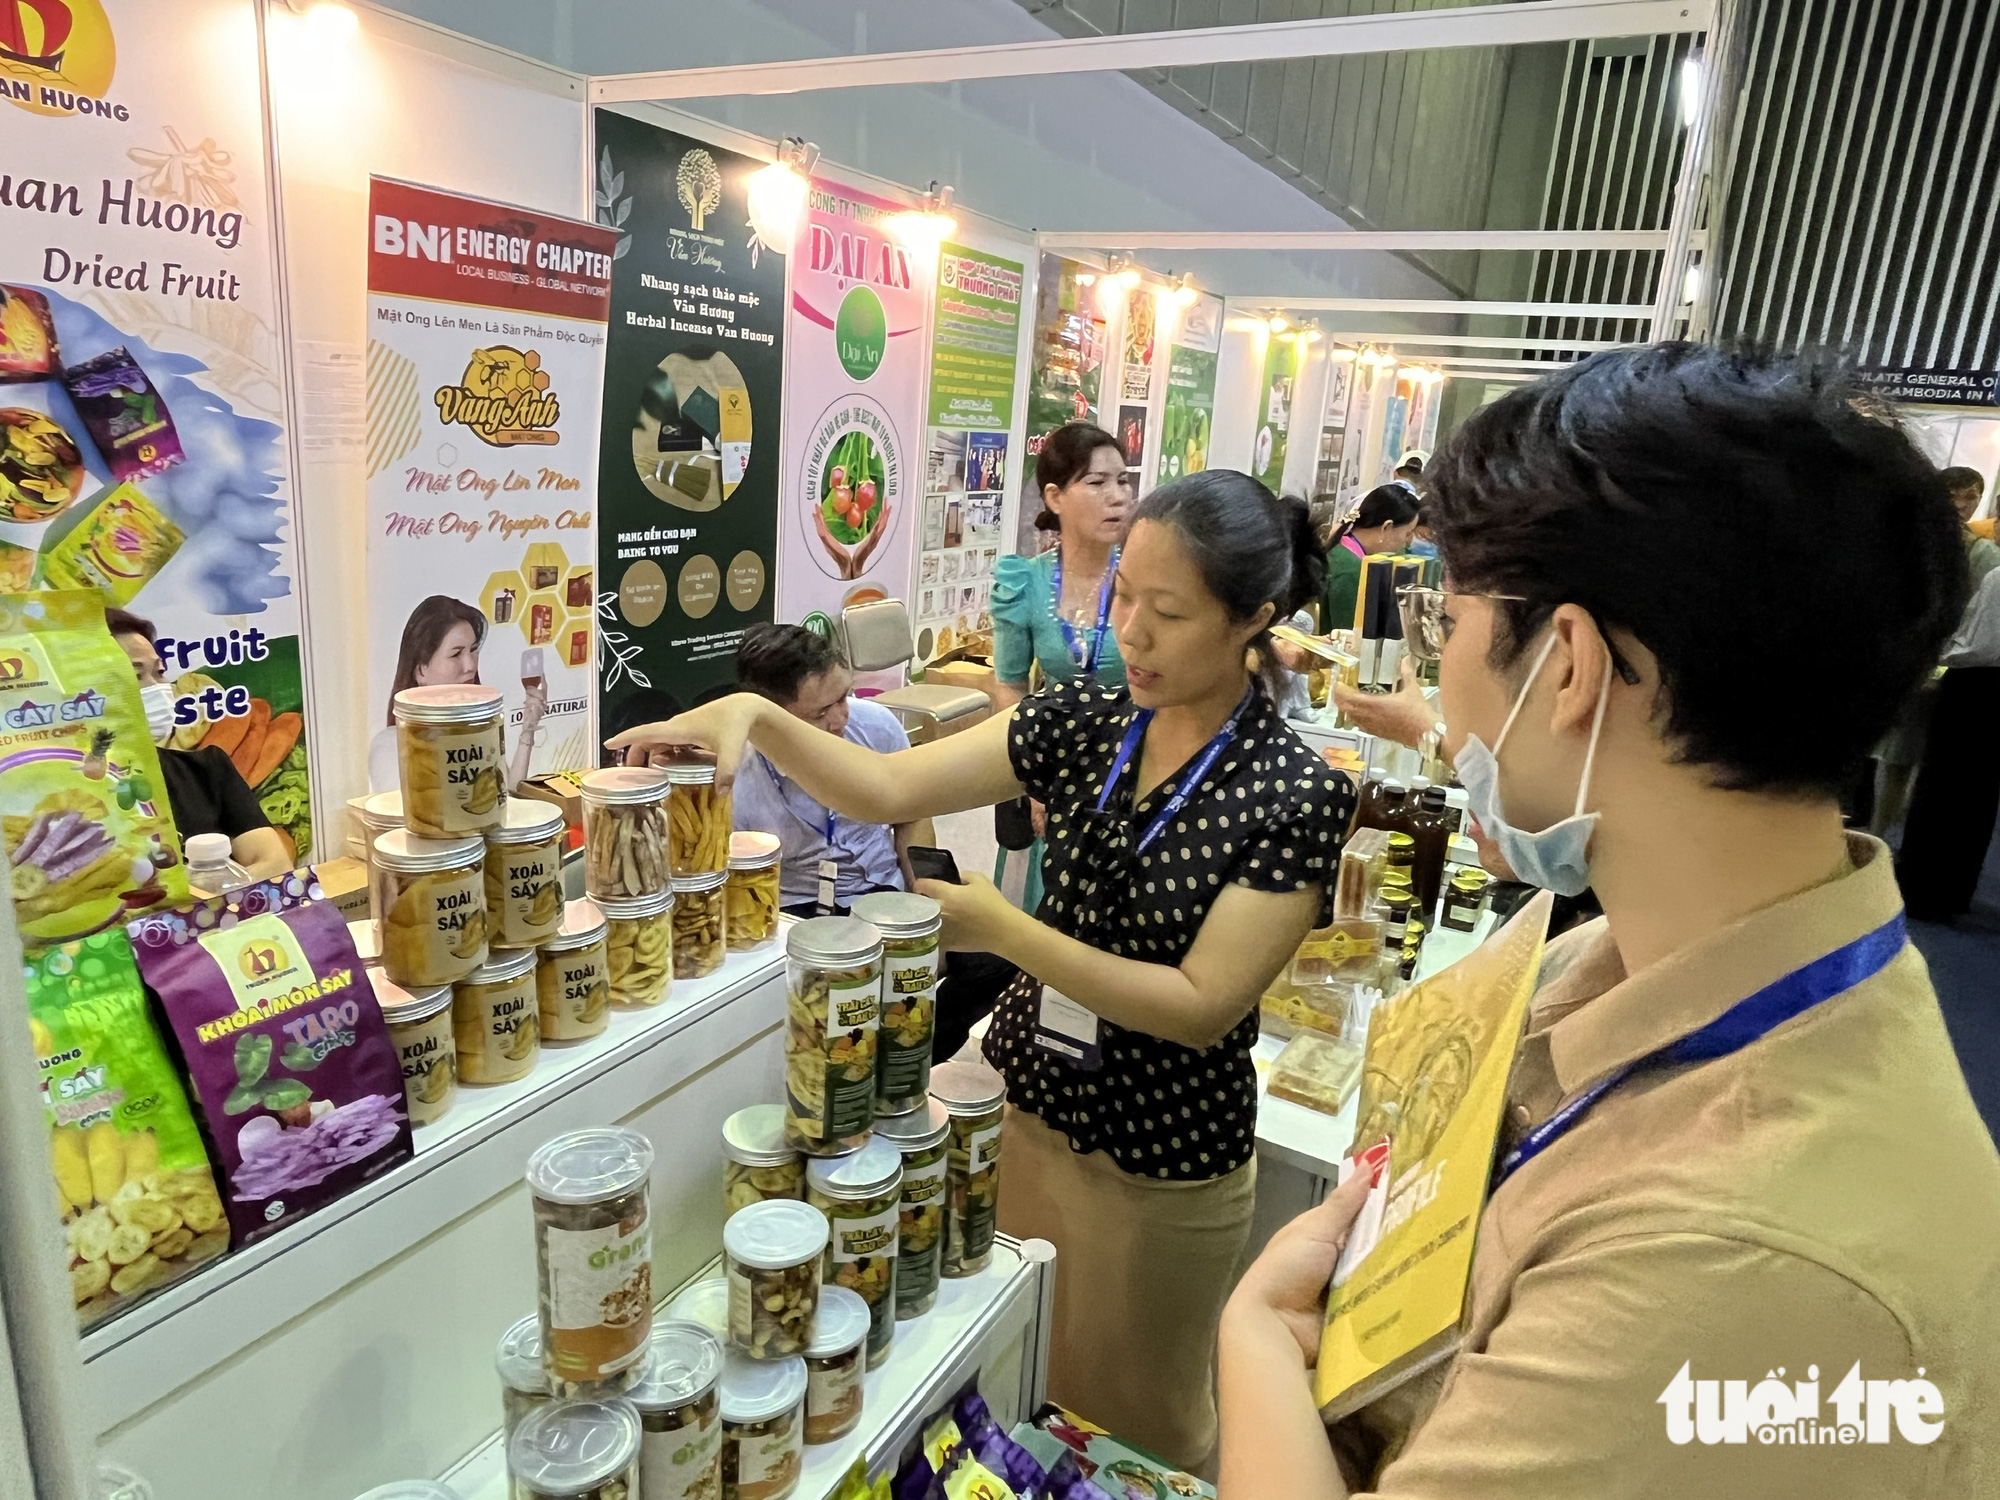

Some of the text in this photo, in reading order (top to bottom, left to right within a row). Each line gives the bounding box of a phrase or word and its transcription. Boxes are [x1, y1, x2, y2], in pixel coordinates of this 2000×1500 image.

[41, 87, 130, 122] HUONG
[99, 179, 243, 249] Huong
[839, 199, 850, 217] TY
[456, 227, 531, 265] ENERGY
[536, 243, 612, 280] CHAPTER
[43, 248, 241, 302] Dried Fruit
[457, 264, 486, 279] LOCAL
[487, 268, 530, 285] BUSINESS
[536, 278, 570, 292] GLOBAL
[570, 282, 606, 297] NETWORK
[640, 273, 760, 308] Nhang sạch thảo mộc
[377, 308, 402, 324] Mật
[406, 311, 430, 328] Ong
[434, 315, 456, 328] Lên
[459, 318, 482, 332] Men
[485, 320, 499, 333] Là
[672, 298, 696, 314] Vân
[626, 311, 774, 347] Herbal Incense Van Huong
[1880, 386, 1962, 399] CAMBODIA
[1966, 390, 1984, 400] IN
[1907, 373, 1977, 387] GENERAL
[434, 385, 560, 435] Vàng Anh
[446, 744, 483, 785] XOÀI SẤY
[509, 863, 544, 899] XOÀI SẤY
[436, 890, 472, 931] XOÀI SẤY
[564, 964, 595, 1000] XOÀI SẤY
[282, 1000, 360, 1046] TARO
[492, 997, 525, 1036] XOÀI SẤY
[402, 1036, 438, 1079] XOÀI SẤY
